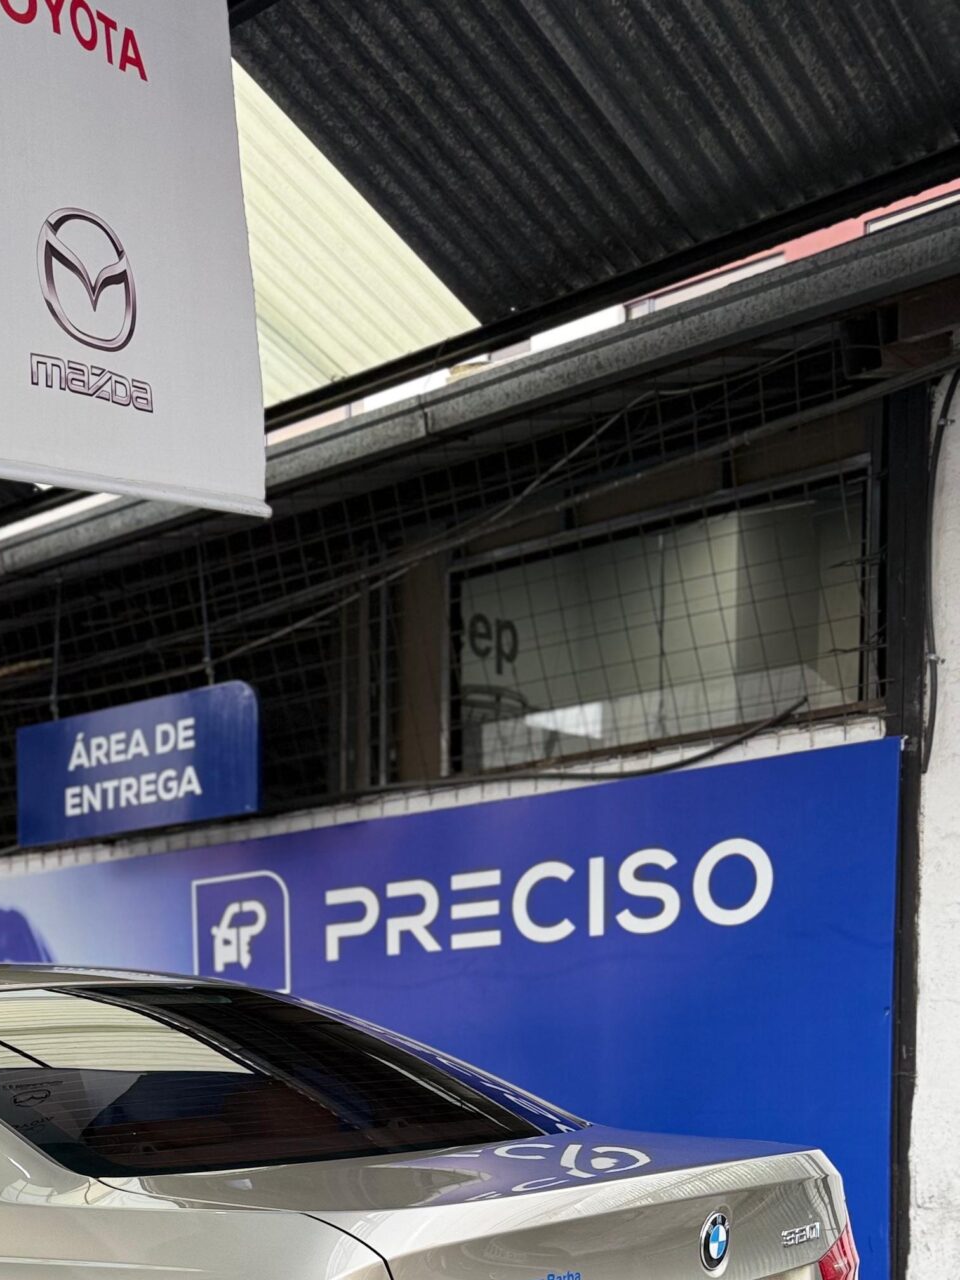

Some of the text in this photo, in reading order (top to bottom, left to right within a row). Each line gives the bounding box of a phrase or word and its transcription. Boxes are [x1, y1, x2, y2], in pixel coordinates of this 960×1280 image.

[460, 612, 520, 675] ep
[68, 717, 196, 772] ÁREA DE
[64, 766, 202, 818] ENTREGA
[325, 837, 774, 962] PRECISO
